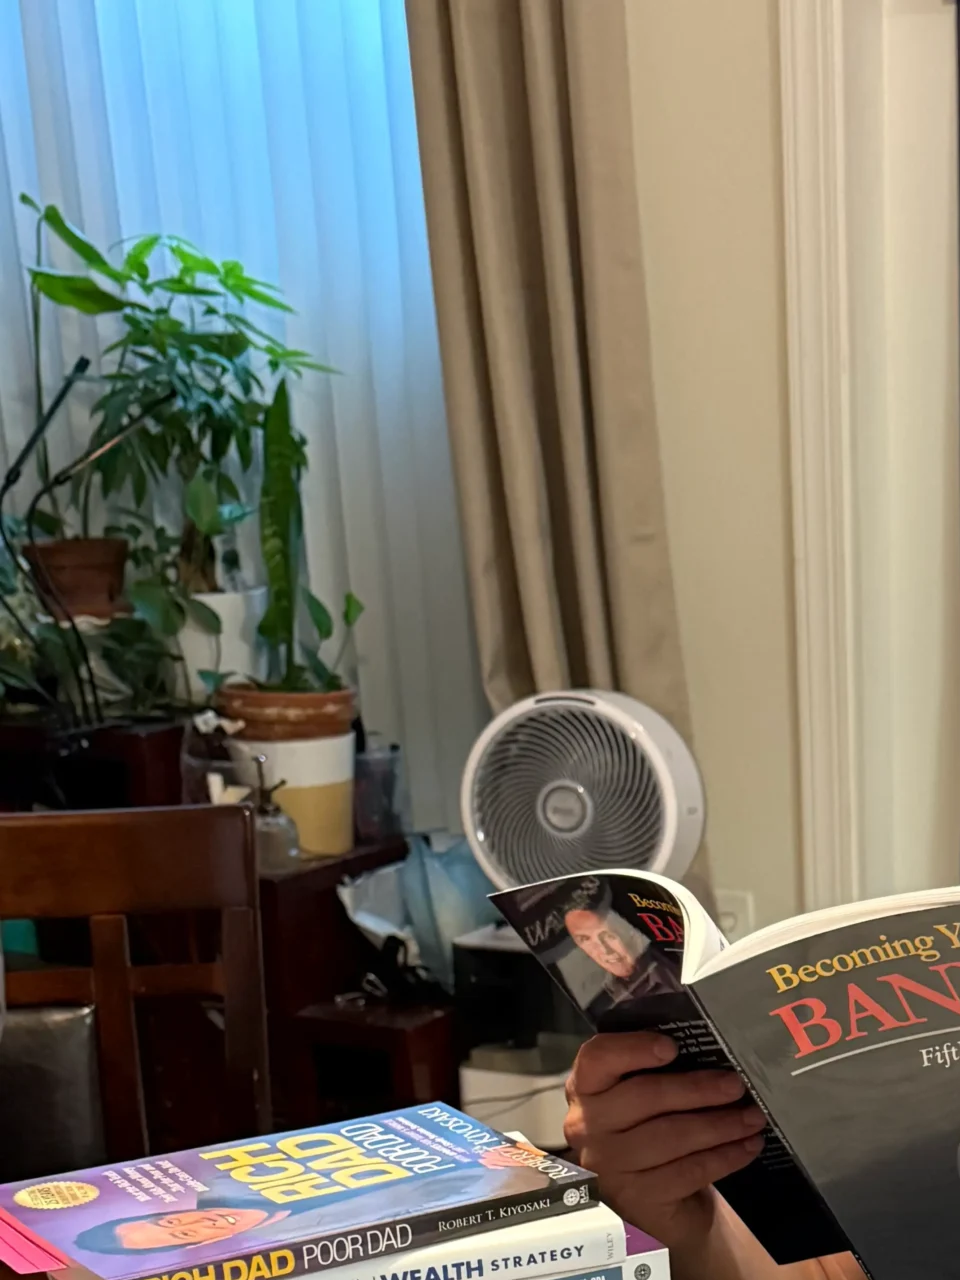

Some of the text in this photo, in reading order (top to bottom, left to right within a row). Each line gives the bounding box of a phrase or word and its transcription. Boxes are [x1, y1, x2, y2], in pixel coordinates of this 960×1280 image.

[766, 934, 941, 994] Becoming
[340, 1123, 405, 1150] DAD
[417, 1107, 497, 1147] KIYOSAKI
[199, 1142, 349, 1205] RICH
[276, 1133, 414, 1189] DAD
[378, 1142, 456, 1174] POOR
[500, 1147, 579, 1180] ROBERT
[302, 1233, 364, 1269] POOR
[367, 1224, 412, 1254] DAD
[438, 1213, 483, 1232] ROBERT
[485, 1208, 497, 1221] T.
[499, 1198, 550, 1218] KIYOSAKI
[606, 1232, 614, 1261] WILEY
[490, 1244, 585, 1272] STRATEGY
